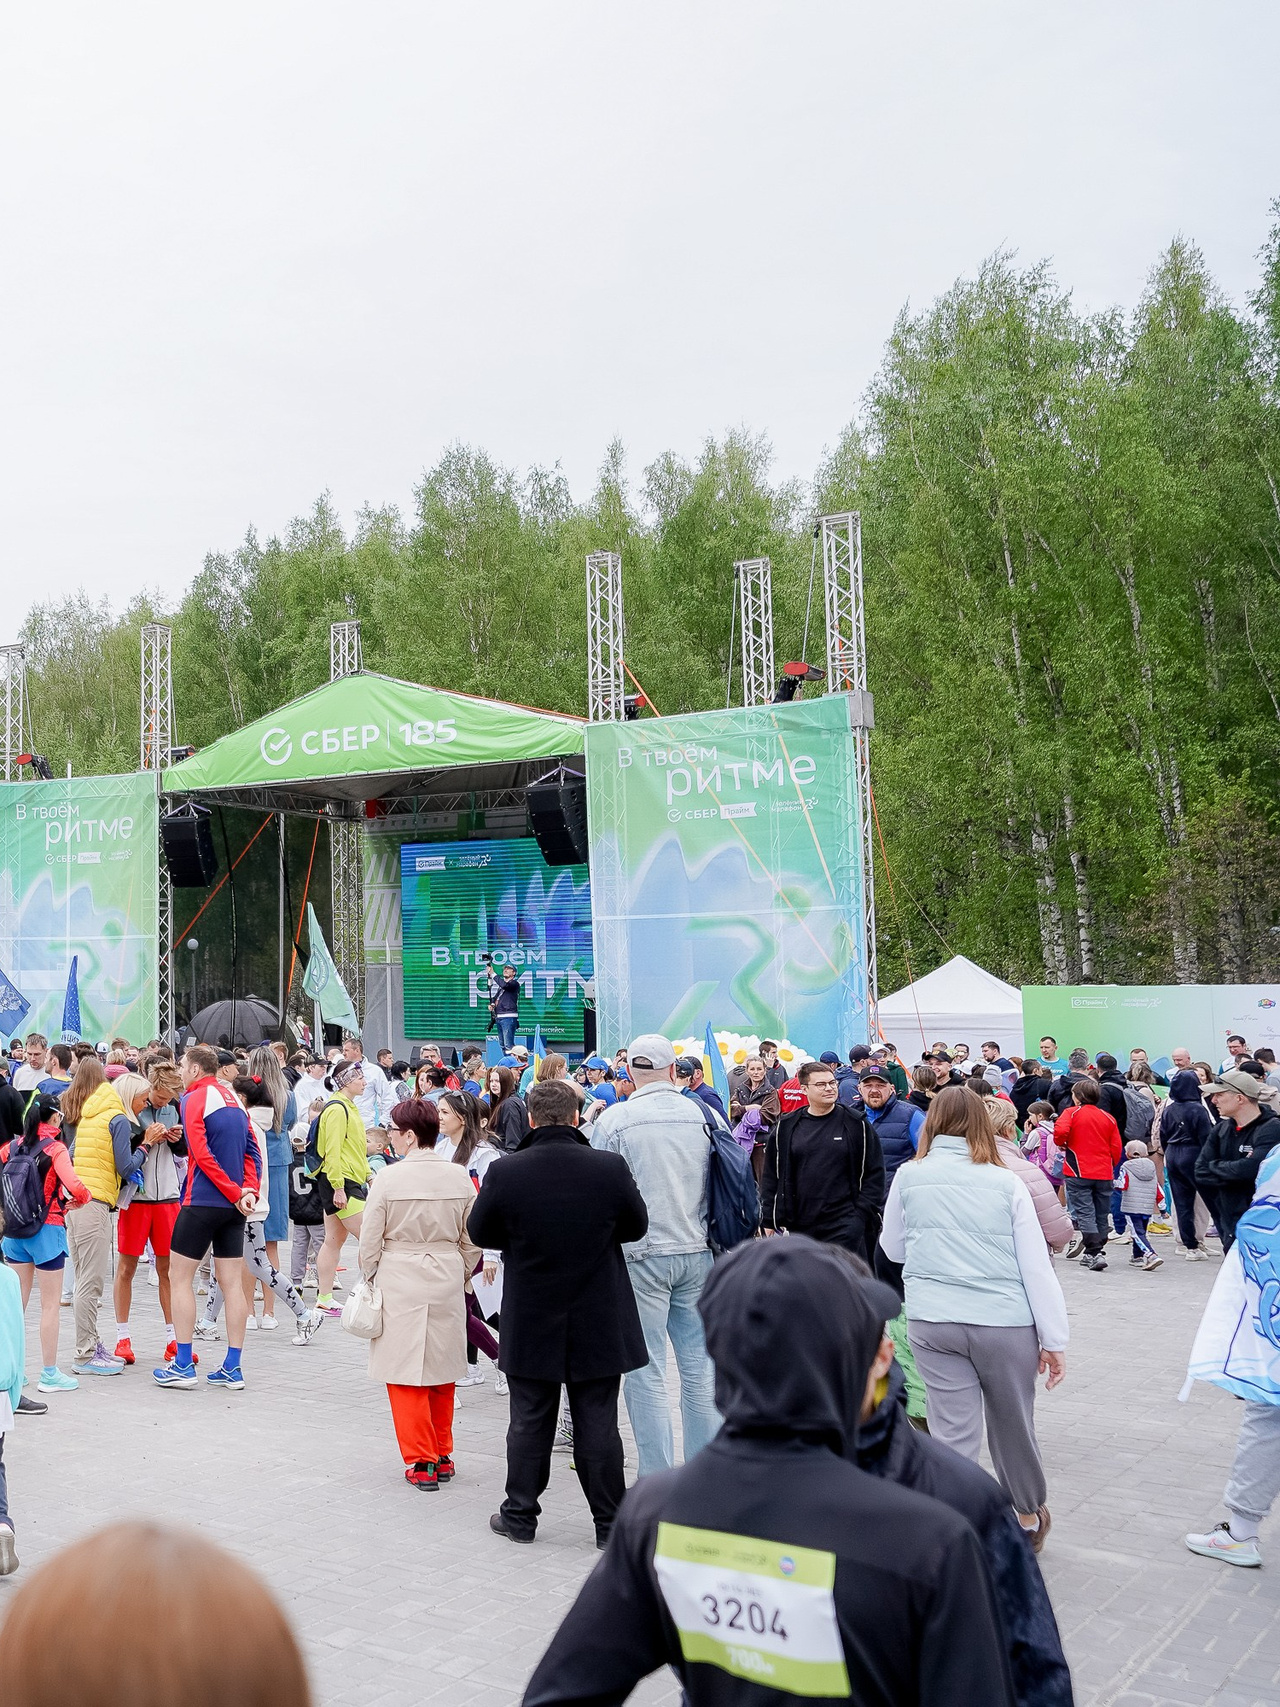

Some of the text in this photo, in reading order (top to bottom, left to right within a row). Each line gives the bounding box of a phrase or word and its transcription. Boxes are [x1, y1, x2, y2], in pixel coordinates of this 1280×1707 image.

[301, 718, 458, 755] СБЕР 185
[618, 743, 718, 768] В твоём
[666, 755, 817, 806] ритме
[16, 802, 80, 820] В твоём
[685, 807, 750, 819] СБЕР Прайм
[46, 816, 134, 851] ритме
[432, 943, 547, 965] В твоём
[469, 969, 596, 1008] ритм
[517, 1026, 565, 1034] анты-ансийск
[701, 1593, 788, 1640] 3204
